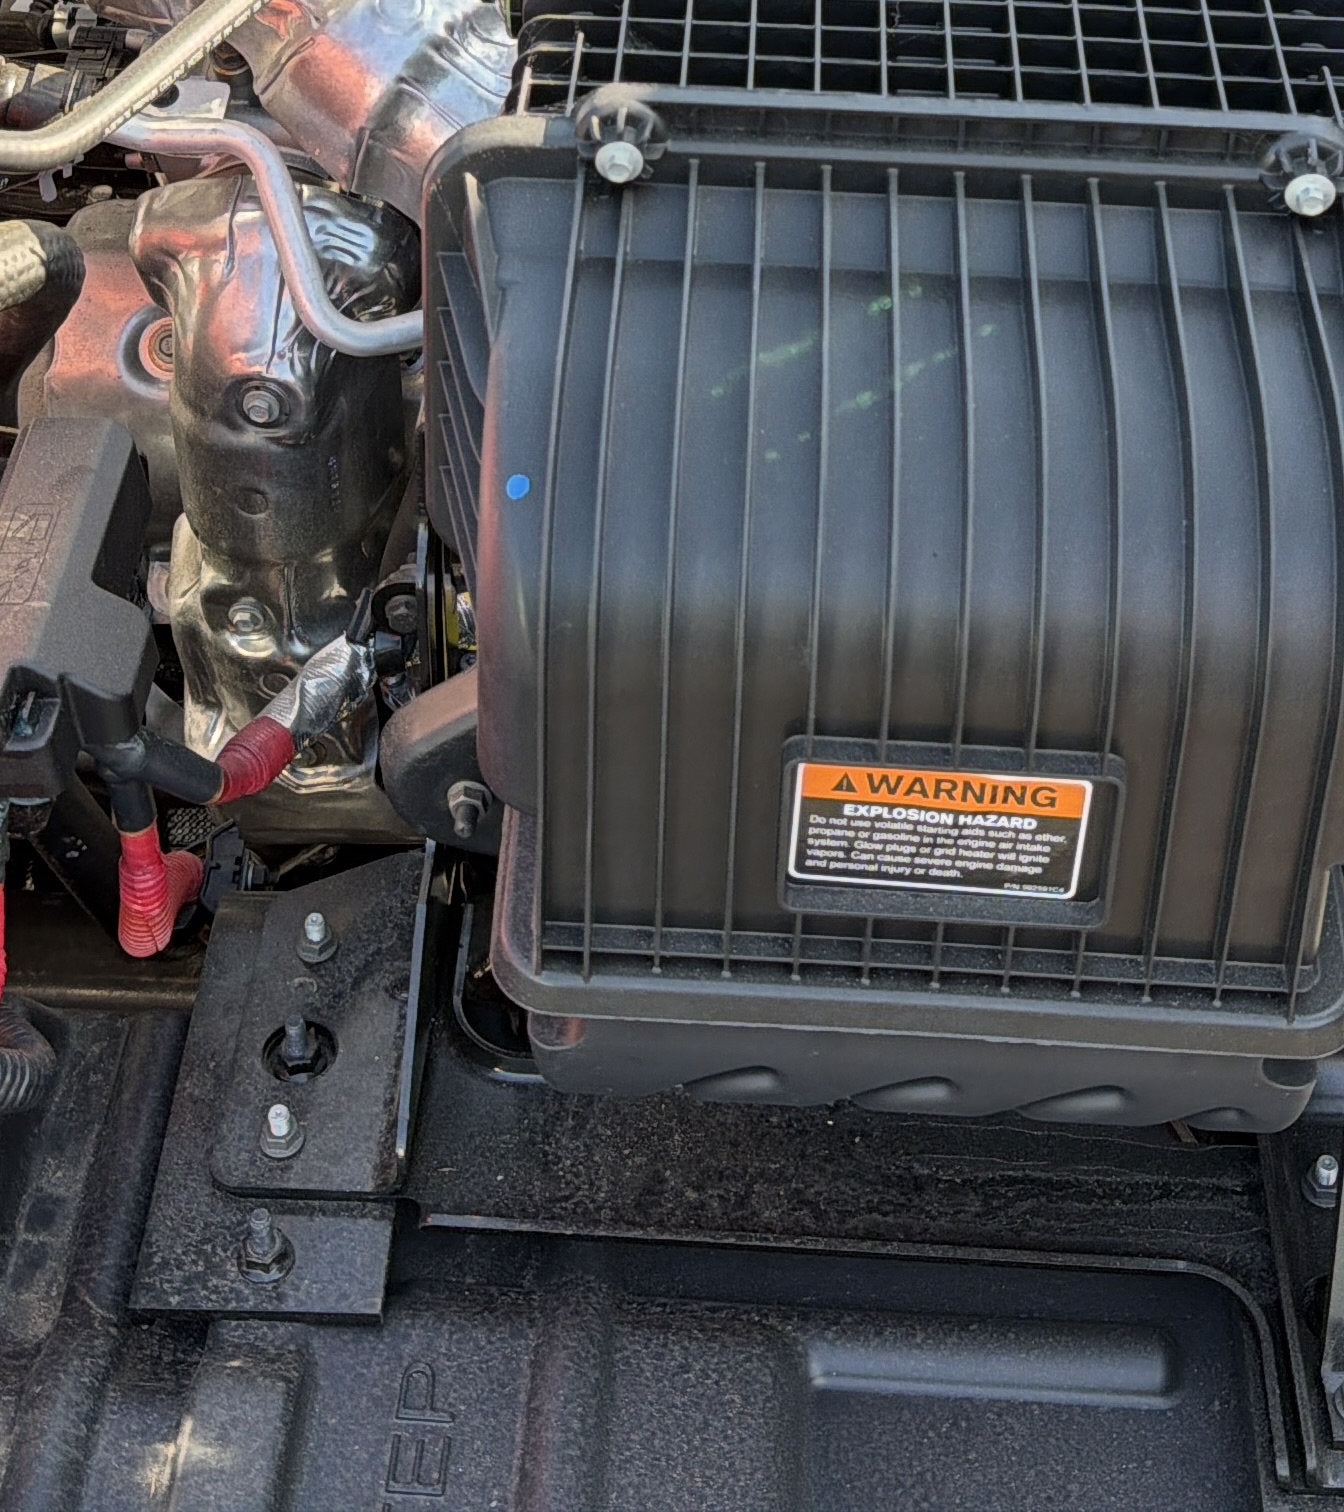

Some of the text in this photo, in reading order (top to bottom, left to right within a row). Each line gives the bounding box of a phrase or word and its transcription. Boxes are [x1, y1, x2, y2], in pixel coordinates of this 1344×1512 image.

[866, 772, 1058, 809] WARNING
[808, 813, 827, 825] Do
[828, 816, 848, 827] not
[850, 819, 872, 828] use
[873, 819, 914, 831] volatile
[916, 824, 959, 837] starting
[960, 827, 986, 837] aids
[987, 829, 1016, 839] such
[1018, 833, 1033, 841] as
[843, 803, 1038, 831] EXPLOSION HAZARD
[806, 838, 1051, 864] system. Glow plugs or grid heater will ignite
[808, 826, 1052, 853] propane or gasoline in the engine air intake
[805, 858, 964, 879] and personal injury or death.
[806, 848, 1043, 875] vapors. Can cause severe engine damage
[382, 1362, 455, 1512] EP
